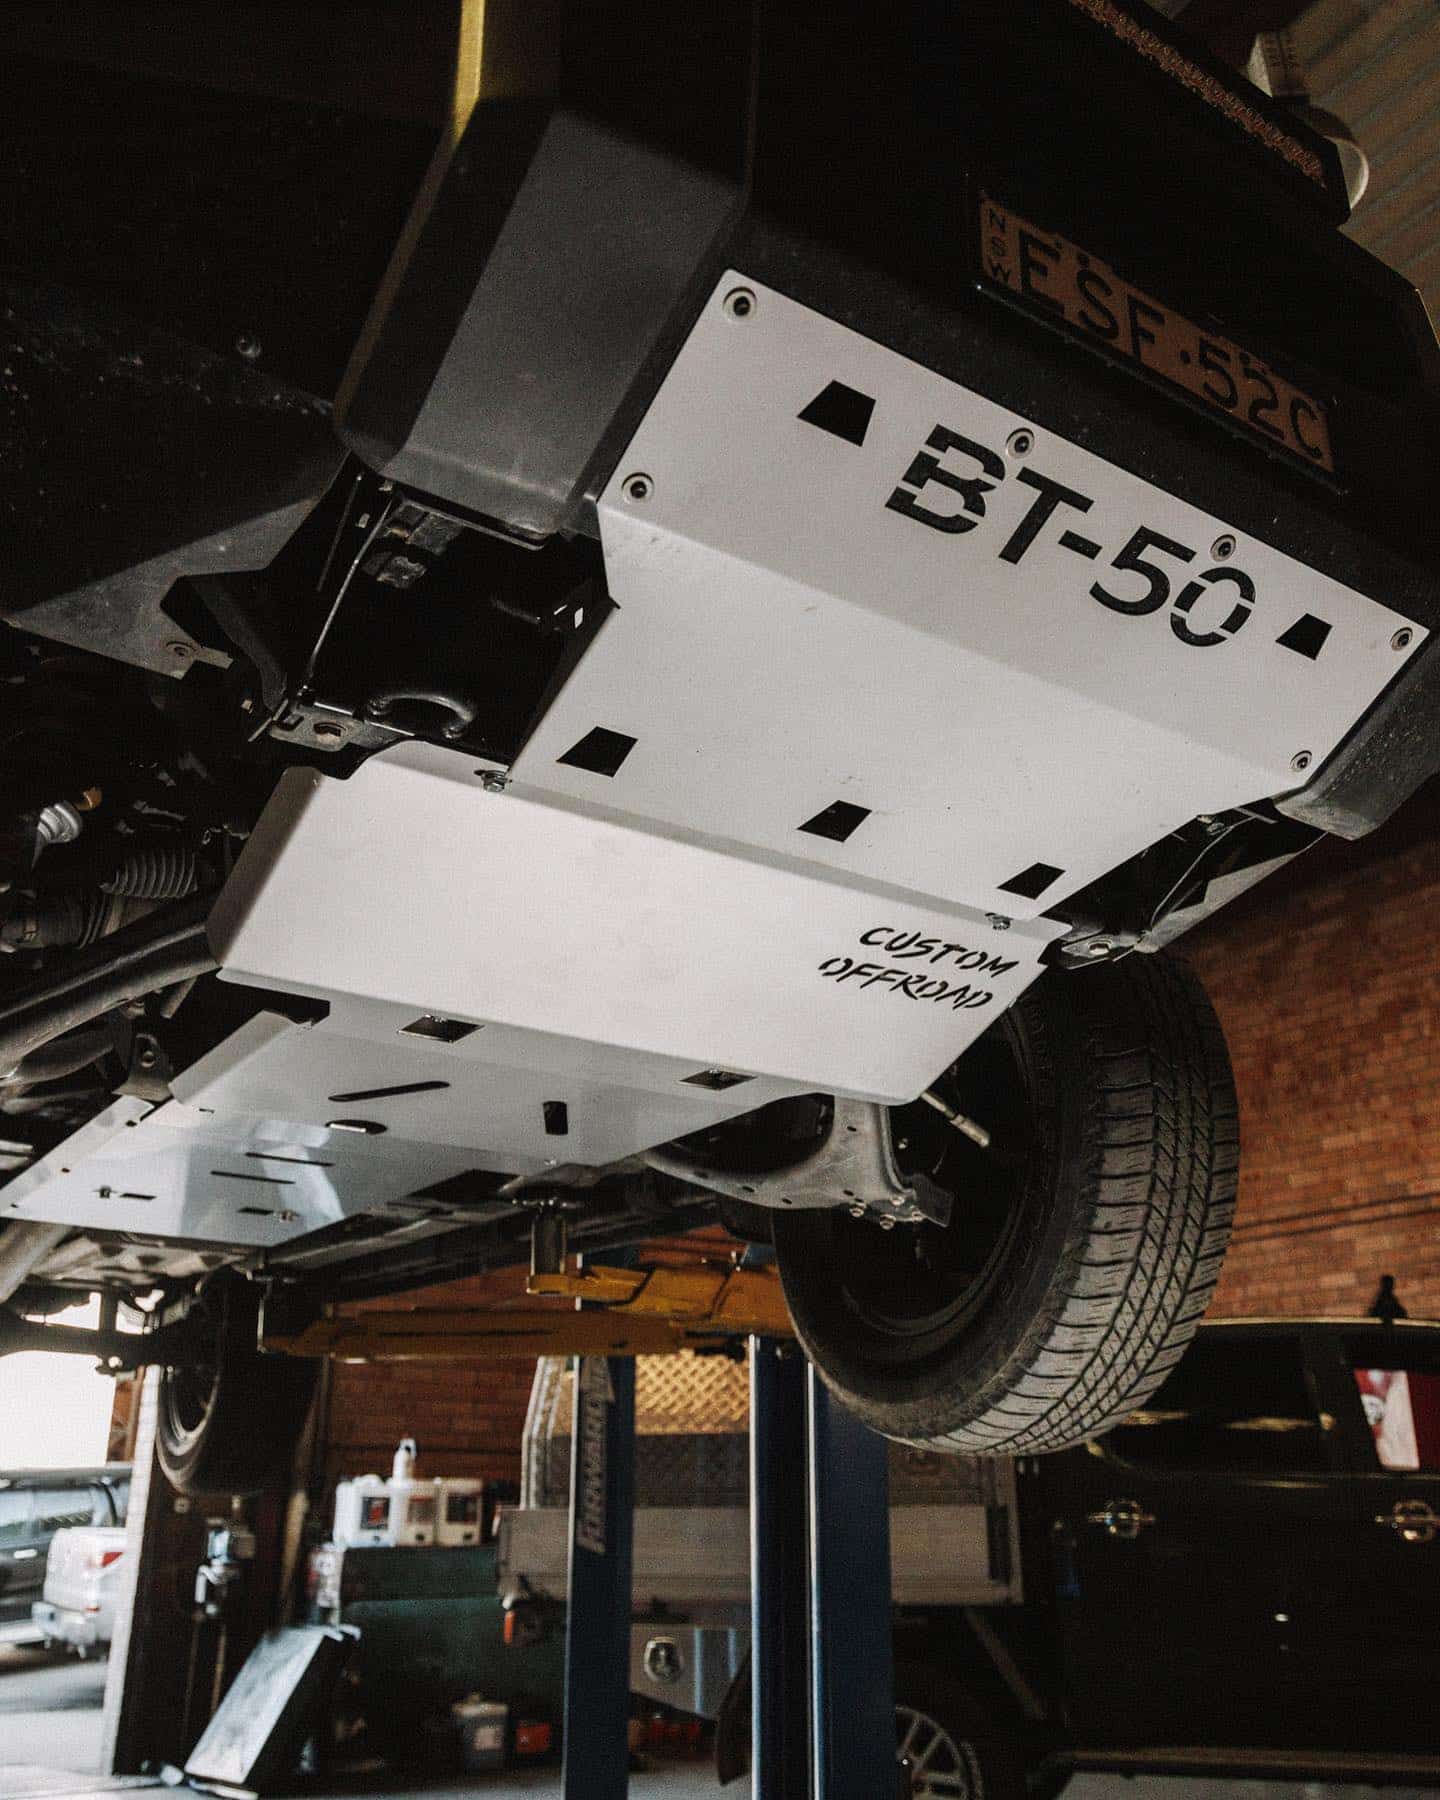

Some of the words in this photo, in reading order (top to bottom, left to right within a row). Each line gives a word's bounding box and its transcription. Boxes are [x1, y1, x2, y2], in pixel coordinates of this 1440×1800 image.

[885, 423, 1256, 647] BT-50
[859, 927, 1019, 978] CUSTOM
[818, 957, 993, 1010] OFFROAD
